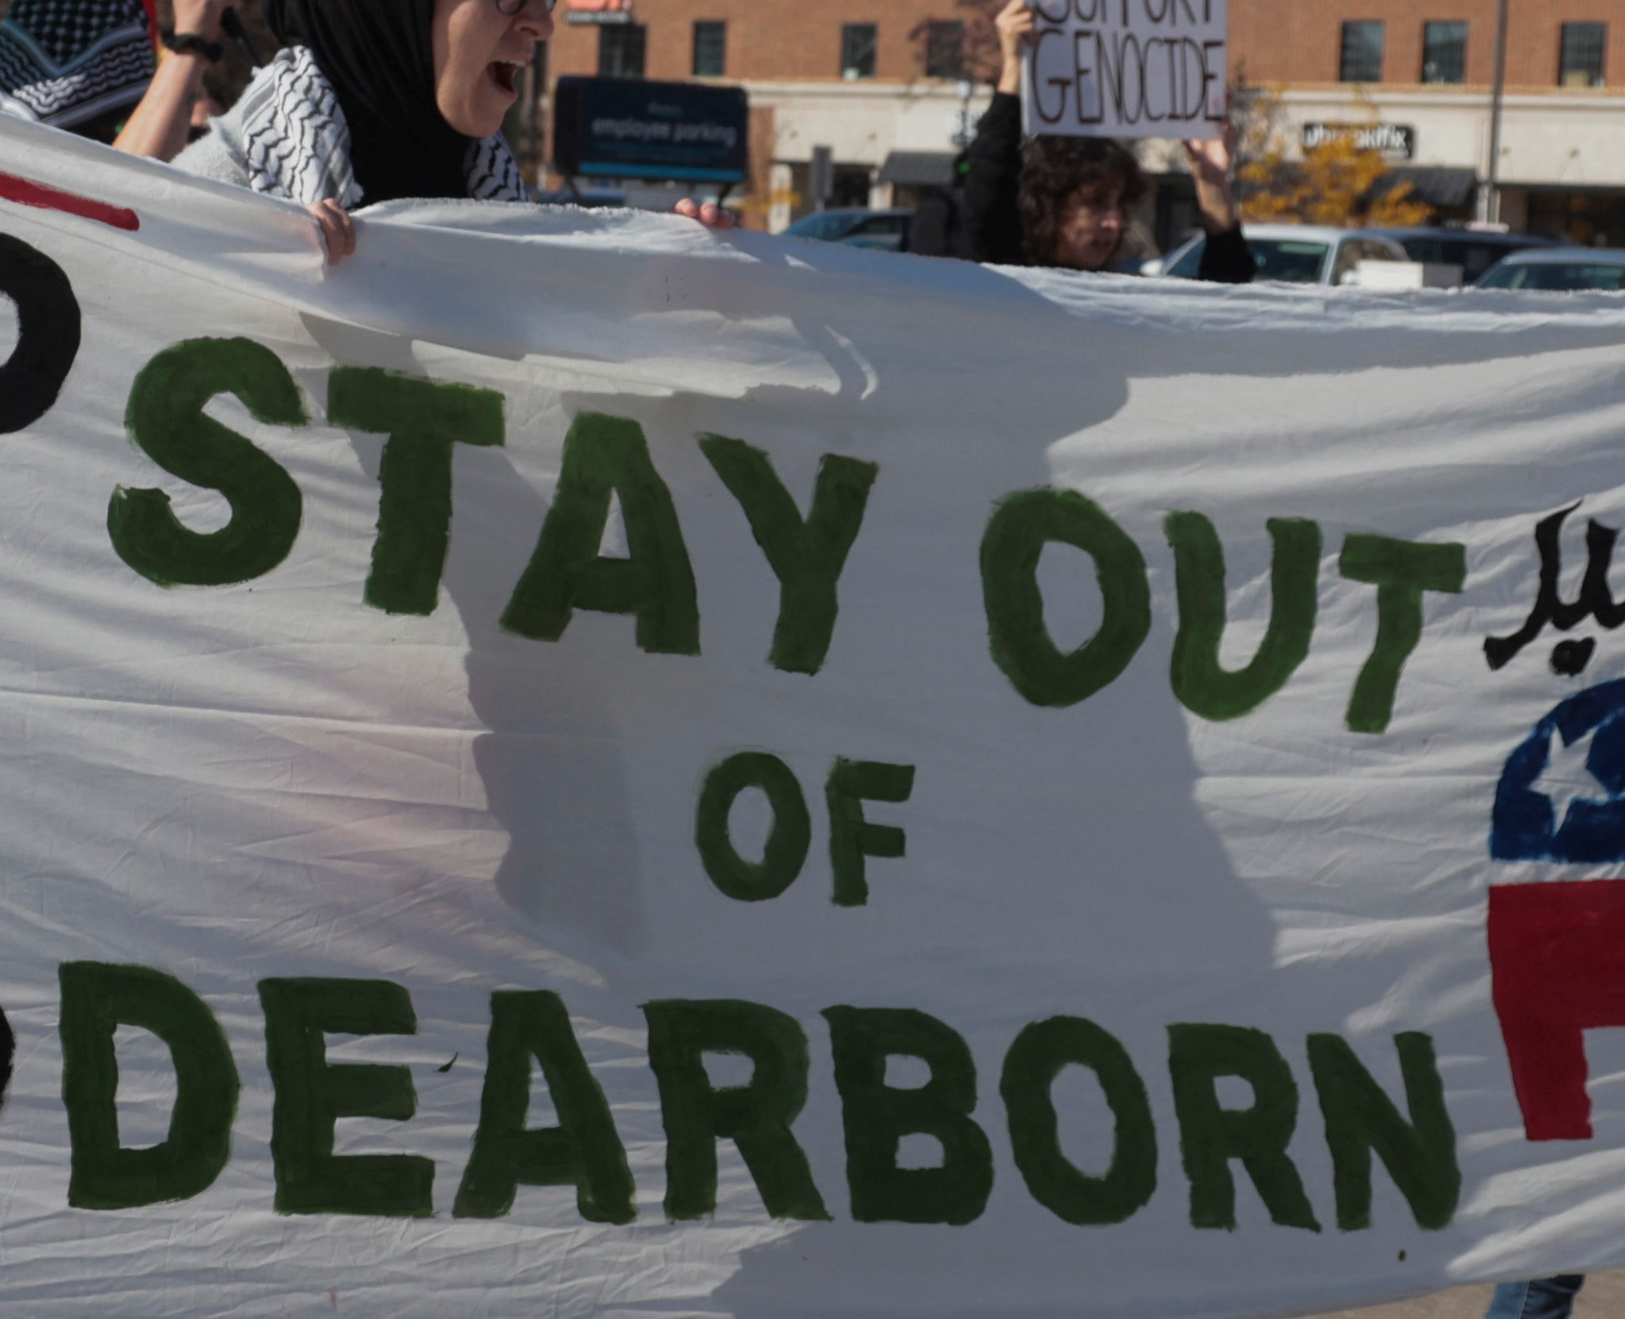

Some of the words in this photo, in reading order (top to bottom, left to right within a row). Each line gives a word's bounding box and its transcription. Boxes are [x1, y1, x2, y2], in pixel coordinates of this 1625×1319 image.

[1031, 27, 1227, 125] GENOCIDE
[107, 336, 879, 676] STAY
[980, 486, 1466, 734] OUT
[694, 749, 917, 907] OF
[58, 960, 1461, 1231] DEARBORN
